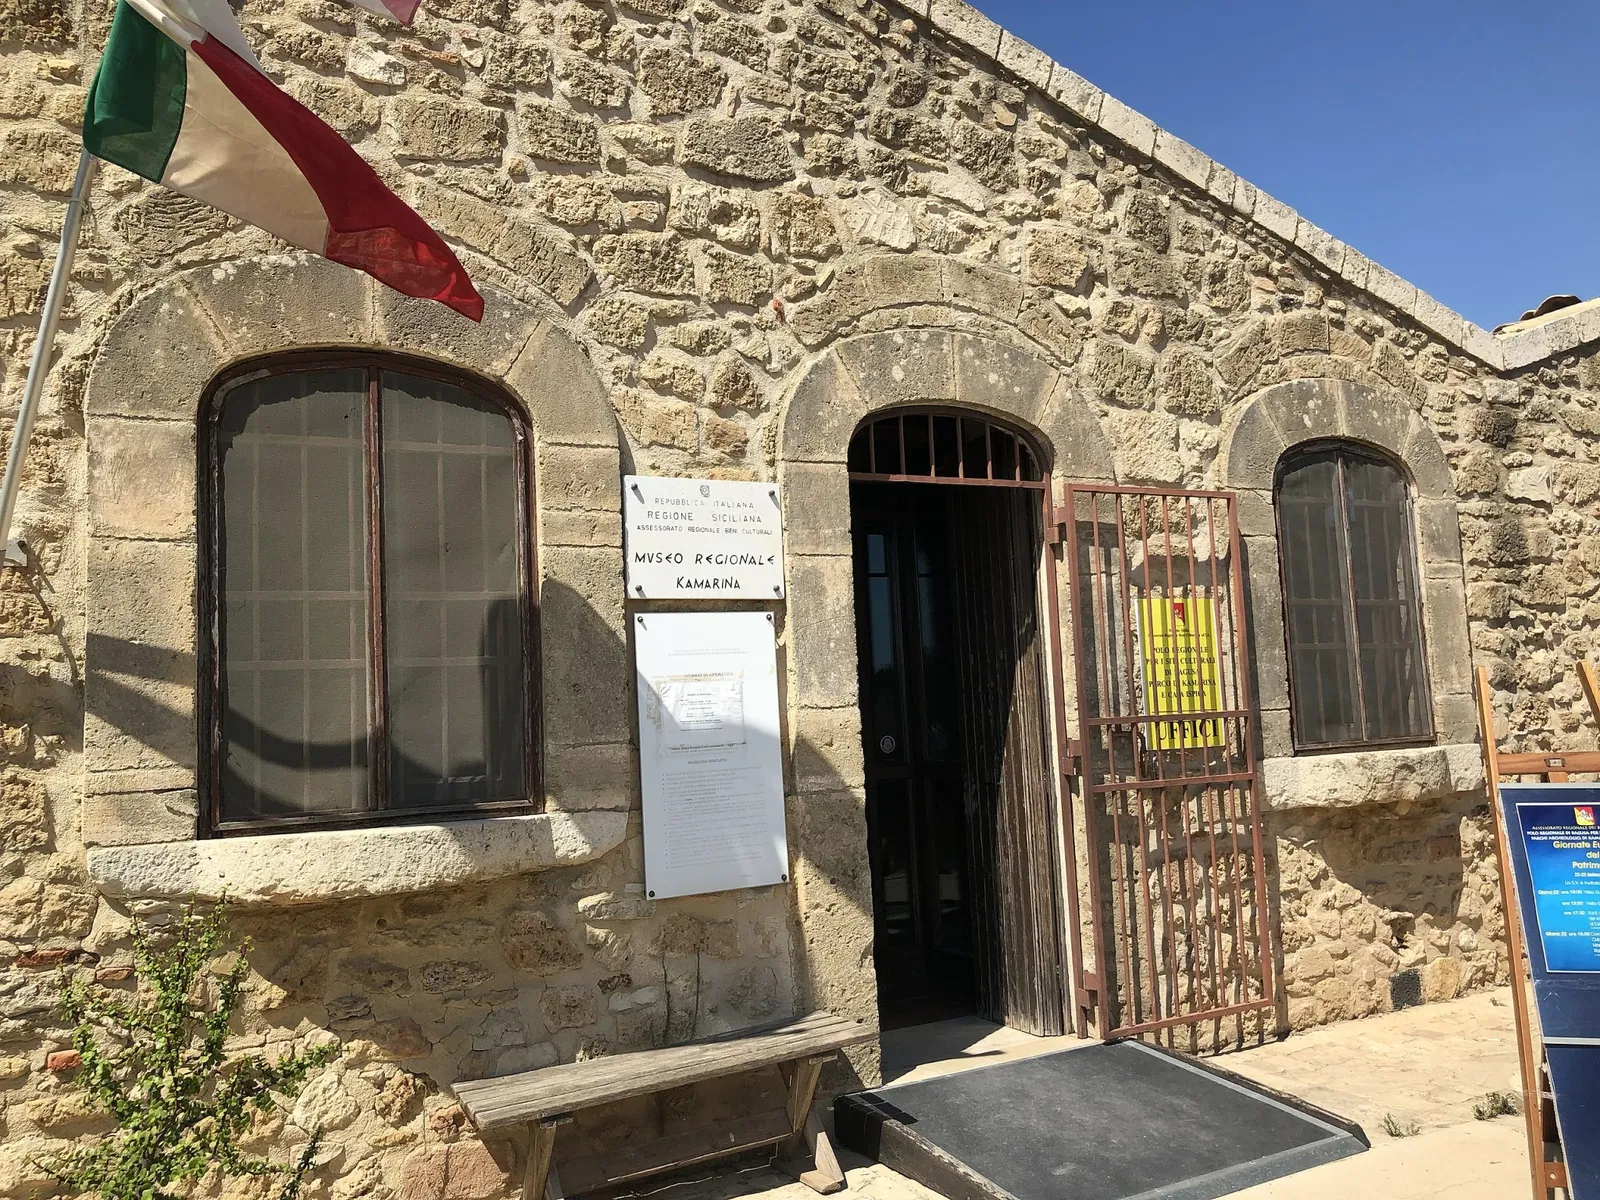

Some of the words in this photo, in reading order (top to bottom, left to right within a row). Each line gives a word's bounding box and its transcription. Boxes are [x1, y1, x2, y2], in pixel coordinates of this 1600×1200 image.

[654, 498, 705, 506] REPUBBLICA
[647, 511, 693, 521] REGIONE
[712, 514, 762, 522] SICILIANA
[695, 553, 775, 565] REGIONALE
[676, 576, 741, 589] KAMARINA
[1156, 719, 1219, 740] UFFICI
[1553, 841, 1590, 849] Giornate
